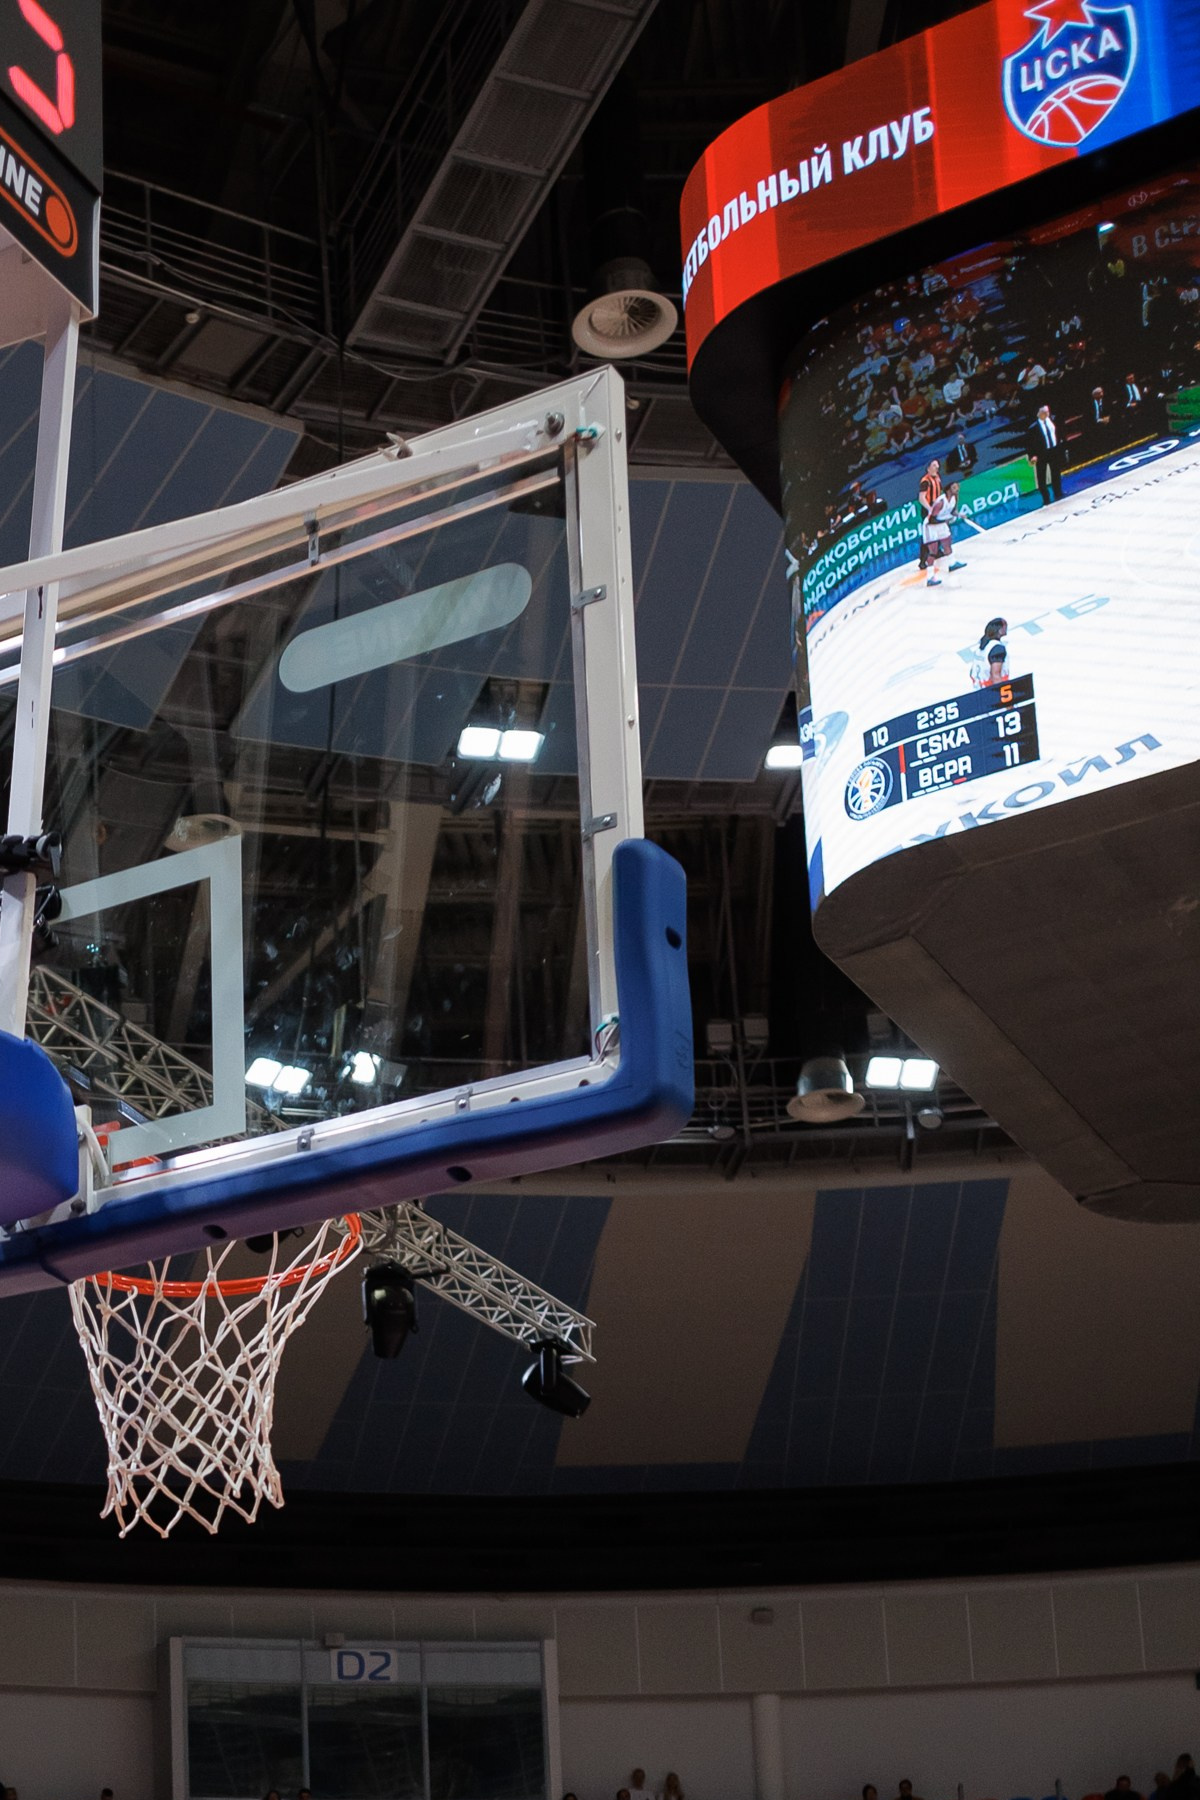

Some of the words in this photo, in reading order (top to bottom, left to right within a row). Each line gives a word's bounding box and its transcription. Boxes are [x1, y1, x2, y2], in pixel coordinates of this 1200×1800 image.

[1019, 28, 1122, 93] ЦСКА
[842, 106, 935, 175] КЛУБ
[958, 482, 1019, 516] АВОД
[872, 726, 889, 747] 1Q
[916, 702, 960, 731] 2:35
[1000, 684, 1013, 703] 5
[916, 726, 970, 759] CSKA
[996, 711, 1022, 738] 13
[1003, 742, 1020, 767] 11
[337, 1650, 392, 1681] D2
